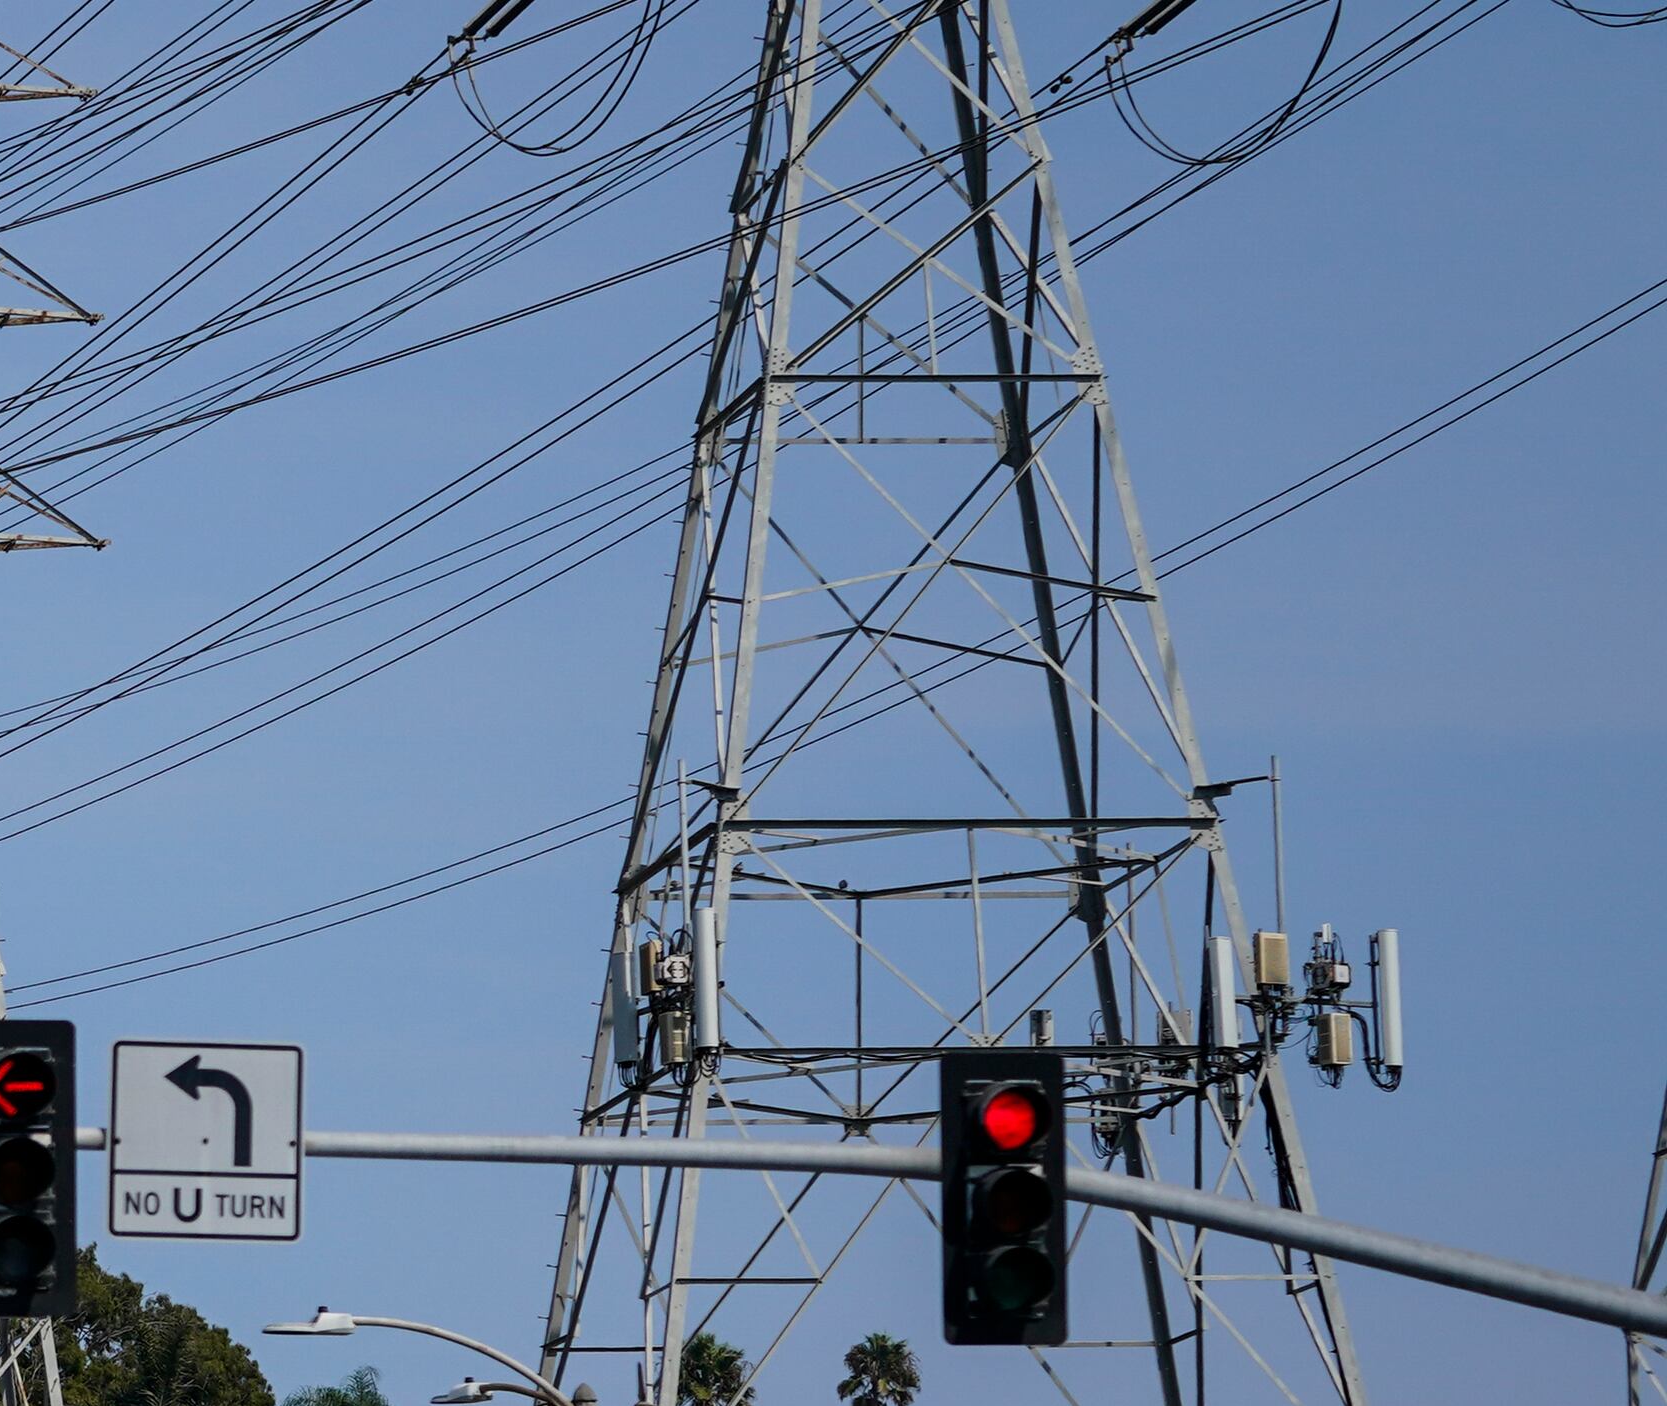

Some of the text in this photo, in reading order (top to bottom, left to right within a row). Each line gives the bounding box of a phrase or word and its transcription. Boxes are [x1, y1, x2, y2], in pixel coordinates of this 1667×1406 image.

[124, 1187, 286, 1223] NO U TURN
